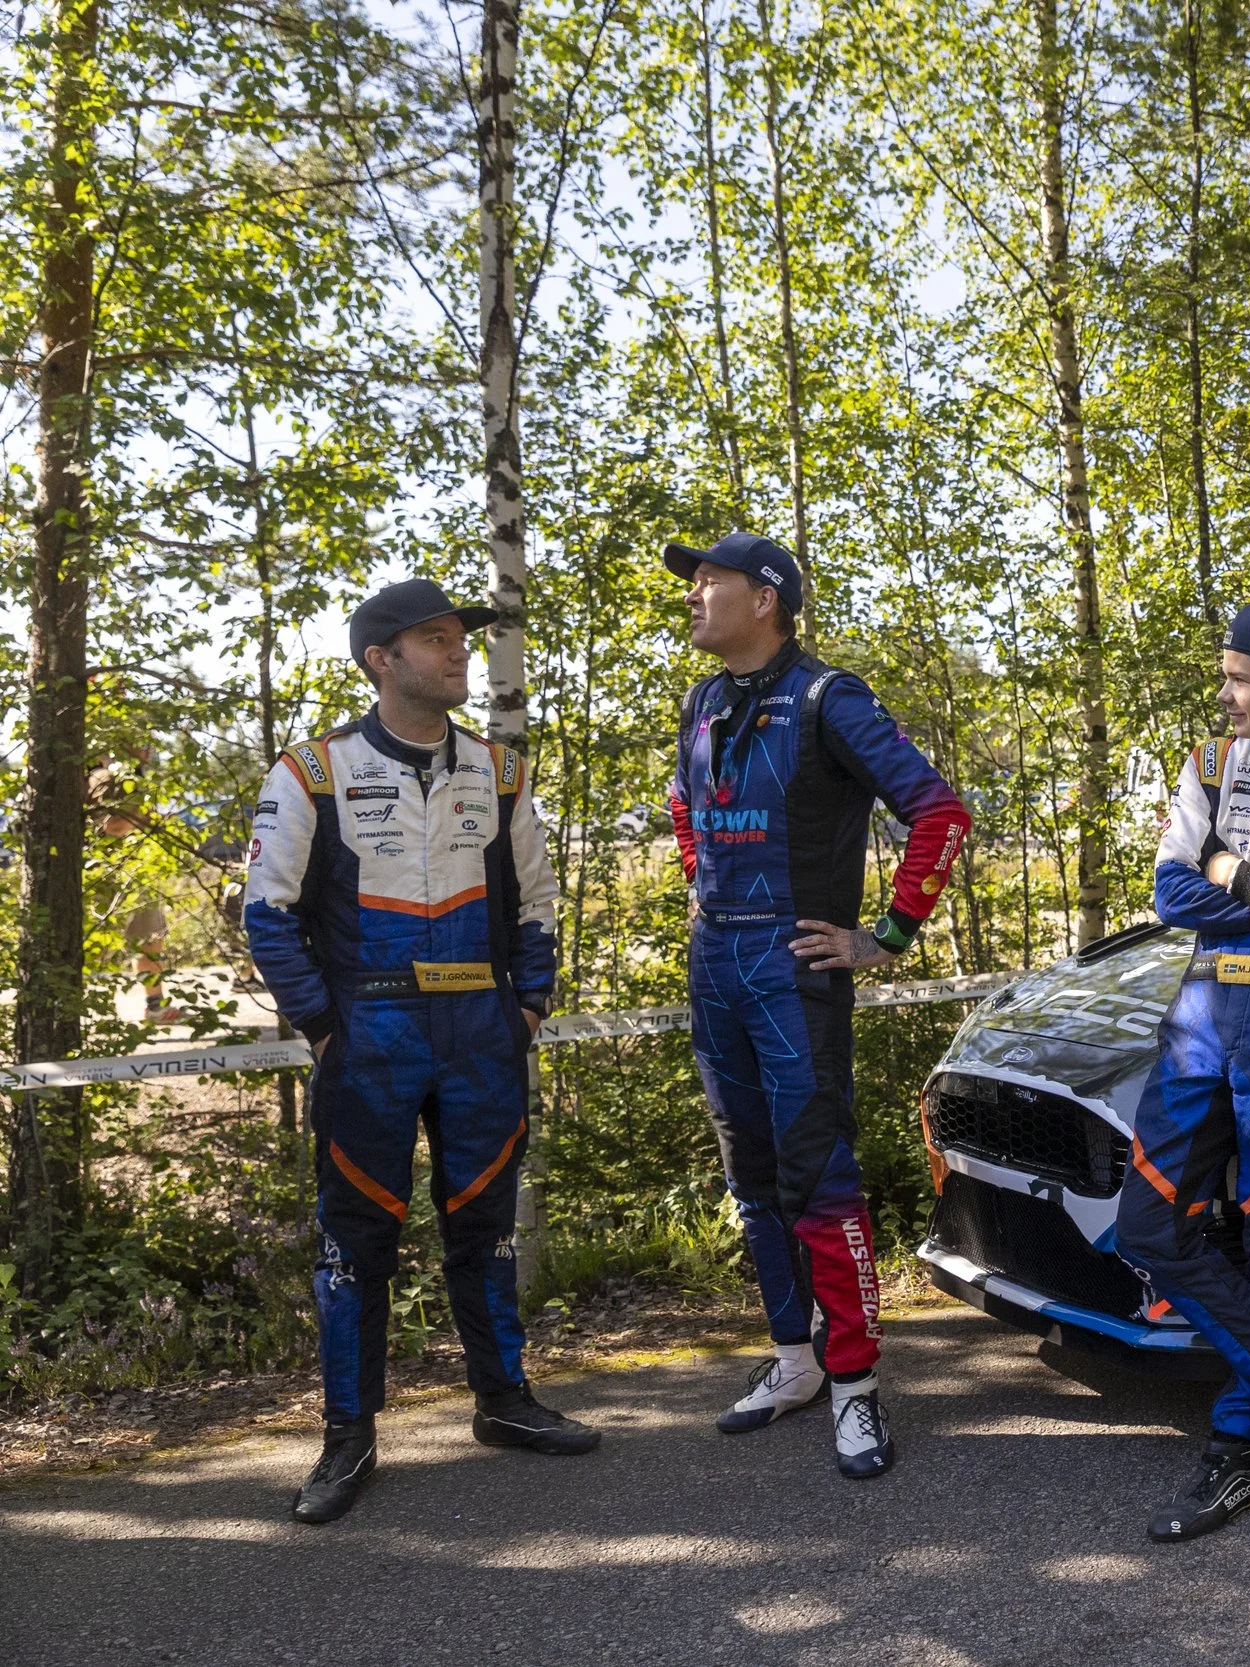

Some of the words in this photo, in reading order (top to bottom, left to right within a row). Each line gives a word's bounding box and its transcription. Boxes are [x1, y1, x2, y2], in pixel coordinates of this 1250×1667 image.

[356, 830, 404, 839] HYRMASKINER
[714, 830, 766, 844] POWER
[934, 841, 952, 871] Crown
[946, 823, 958, 838] Oil
[441, 971, 487, 982] J.GRÖNVALL
